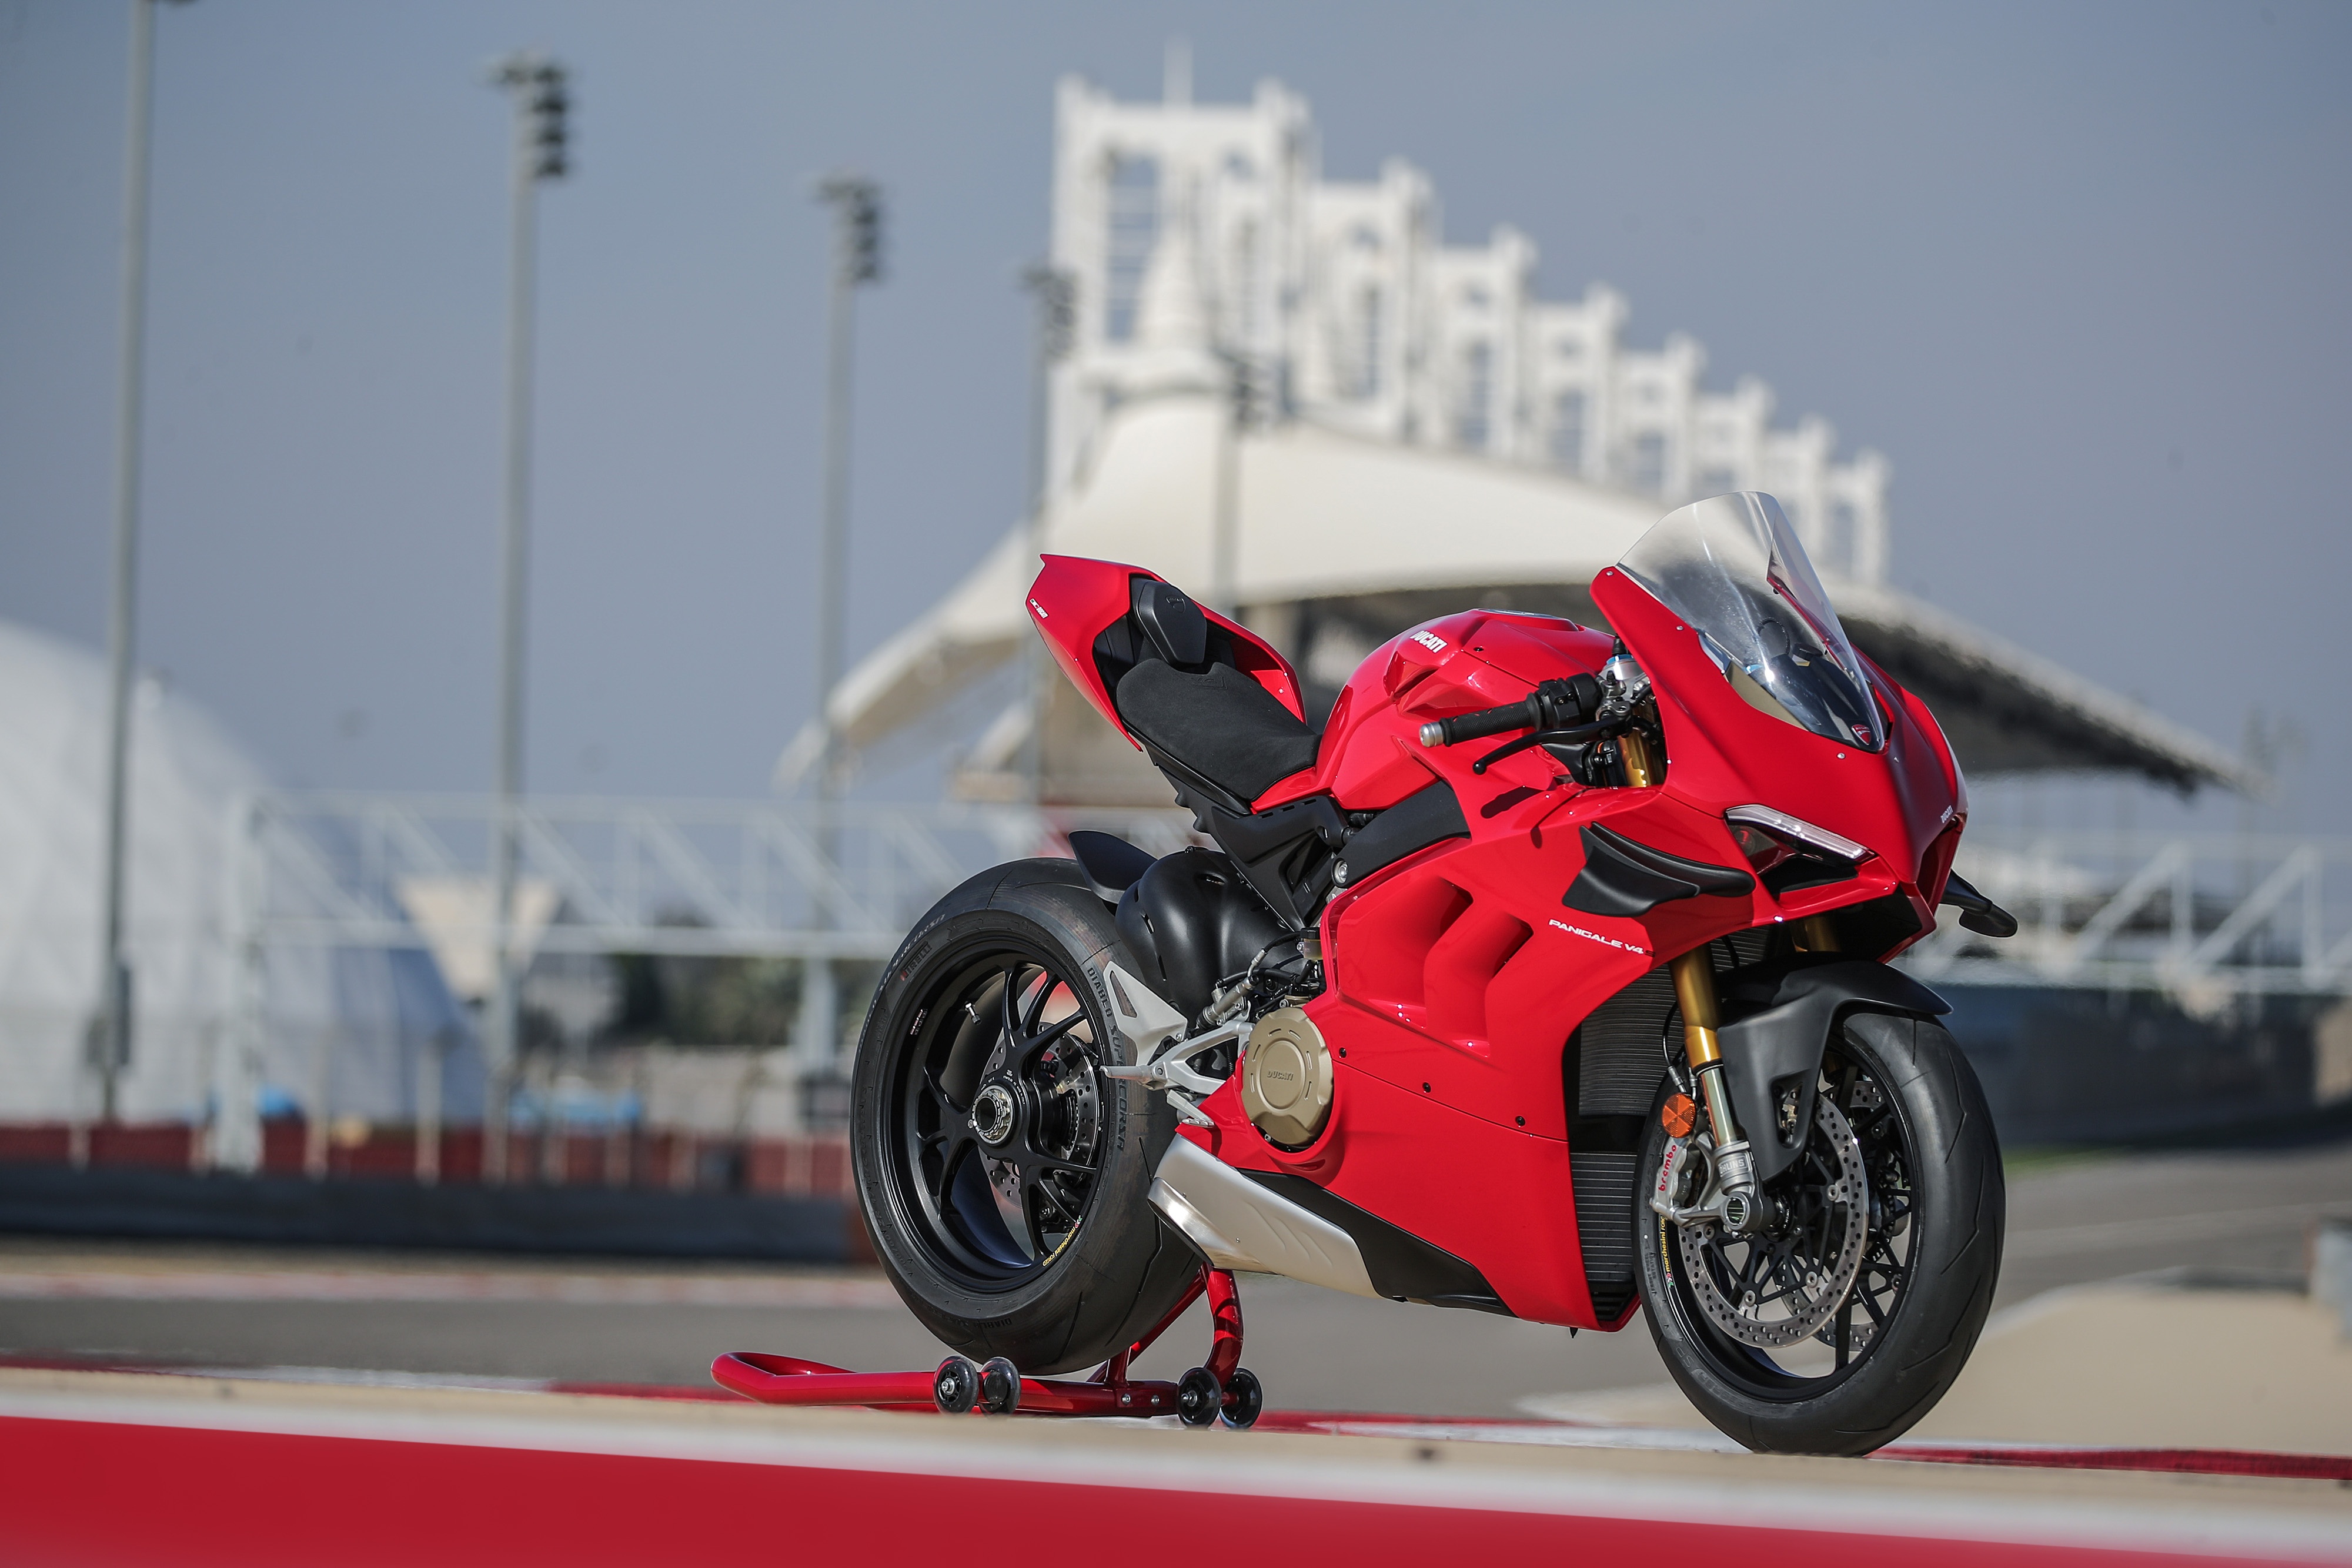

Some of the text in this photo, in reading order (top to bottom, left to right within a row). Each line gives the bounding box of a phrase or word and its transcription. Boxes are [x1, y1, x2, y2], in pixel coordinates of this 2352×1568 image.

[1409, 630, 1448, 653] DUCATI
[1549, 919, 1623, 948] PANIGALE
[1624, 943, 1644, 954] V4
[1087, 967, 1127, 1151] DIABLO SUPECORSA
[1267, 1070, 1294, 1081] DUCATI
[1659, 1145, 1677, 1191] brembo
[1043, 1226, 1076, 1266] marchesini FORGED
[1659, 1231, 1671, 1272] marchesini
